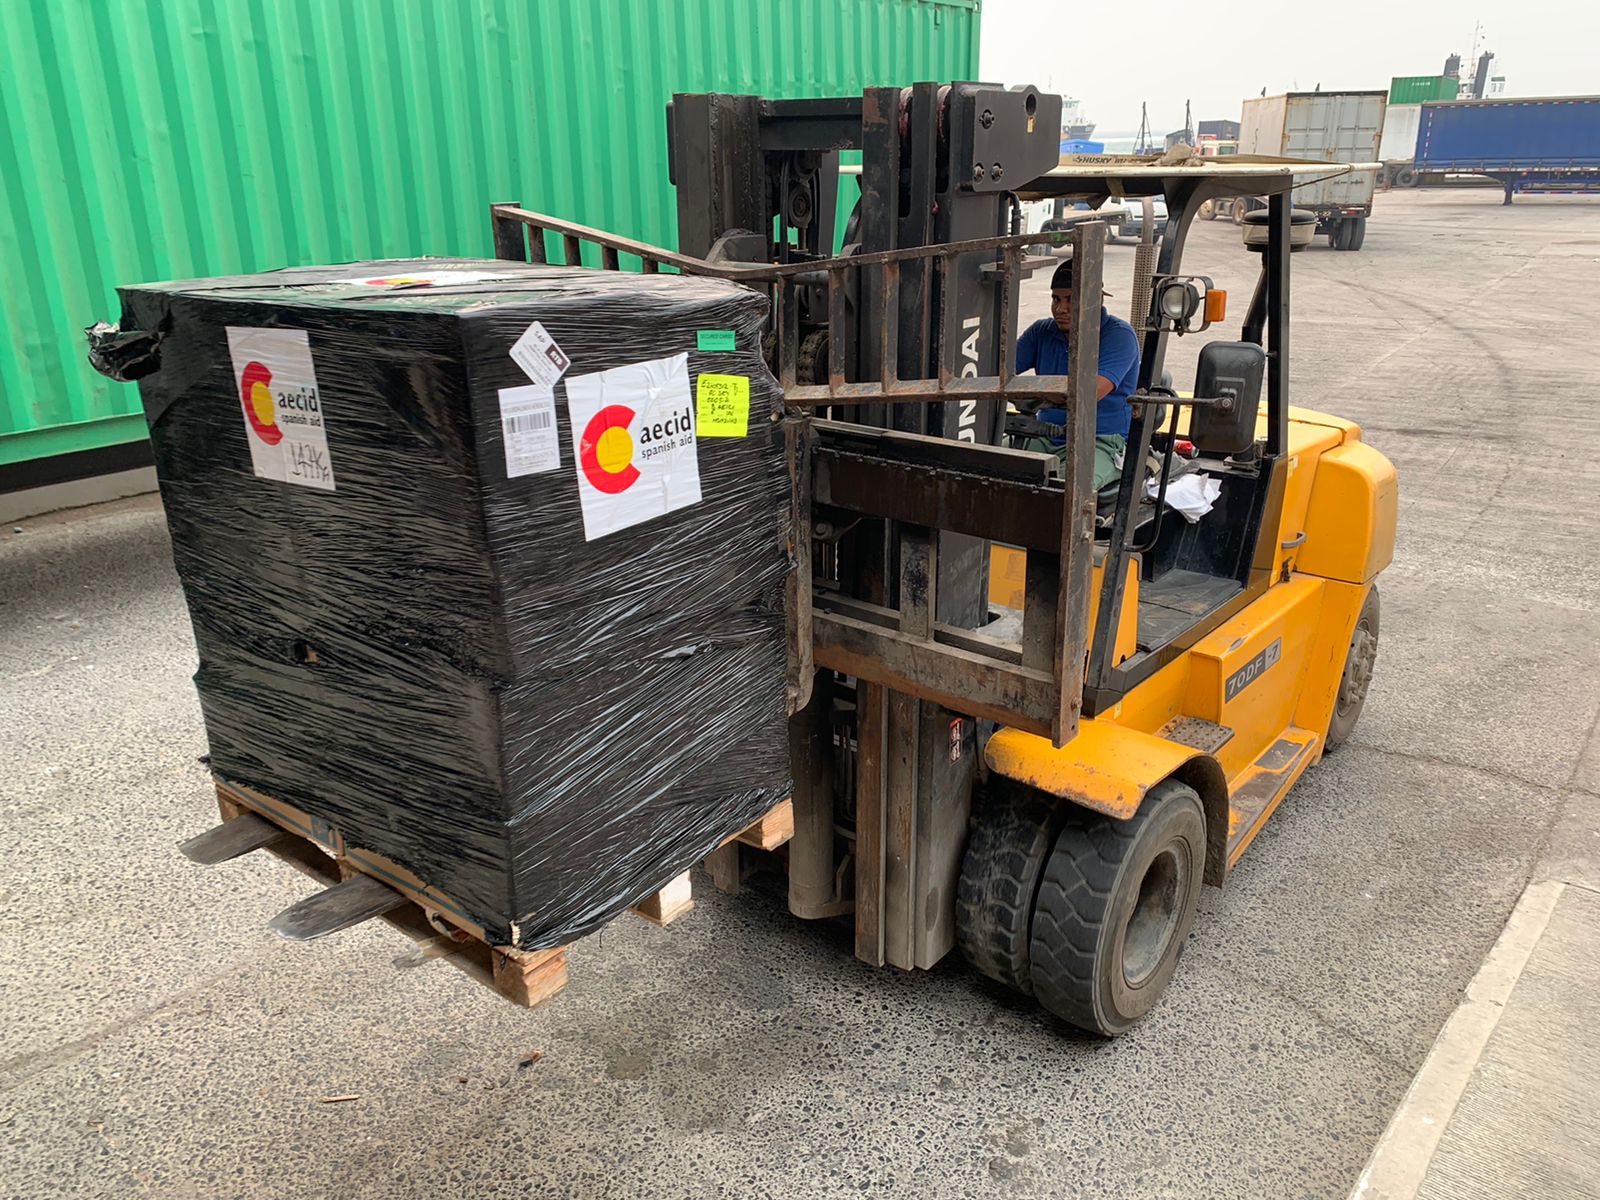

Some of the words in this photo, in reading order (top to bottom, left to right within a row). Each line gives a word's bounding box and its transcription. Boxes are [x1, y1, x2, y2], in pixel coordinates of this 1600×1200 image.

[1082, 156, 1112, 165] HUSKY
[958, 316, 981, 444] UNDAI
[278, 387, 318, 412] aecid
[281, 414, 308, 426] spanish
[310, 415, 321, 427] aid
[640, 407, 691, 444] aecid
[641, 439, 676, 460] spanish
[680, 432, 692, 446] aid
[1229, 643, 1279, 695] 70DF-7
